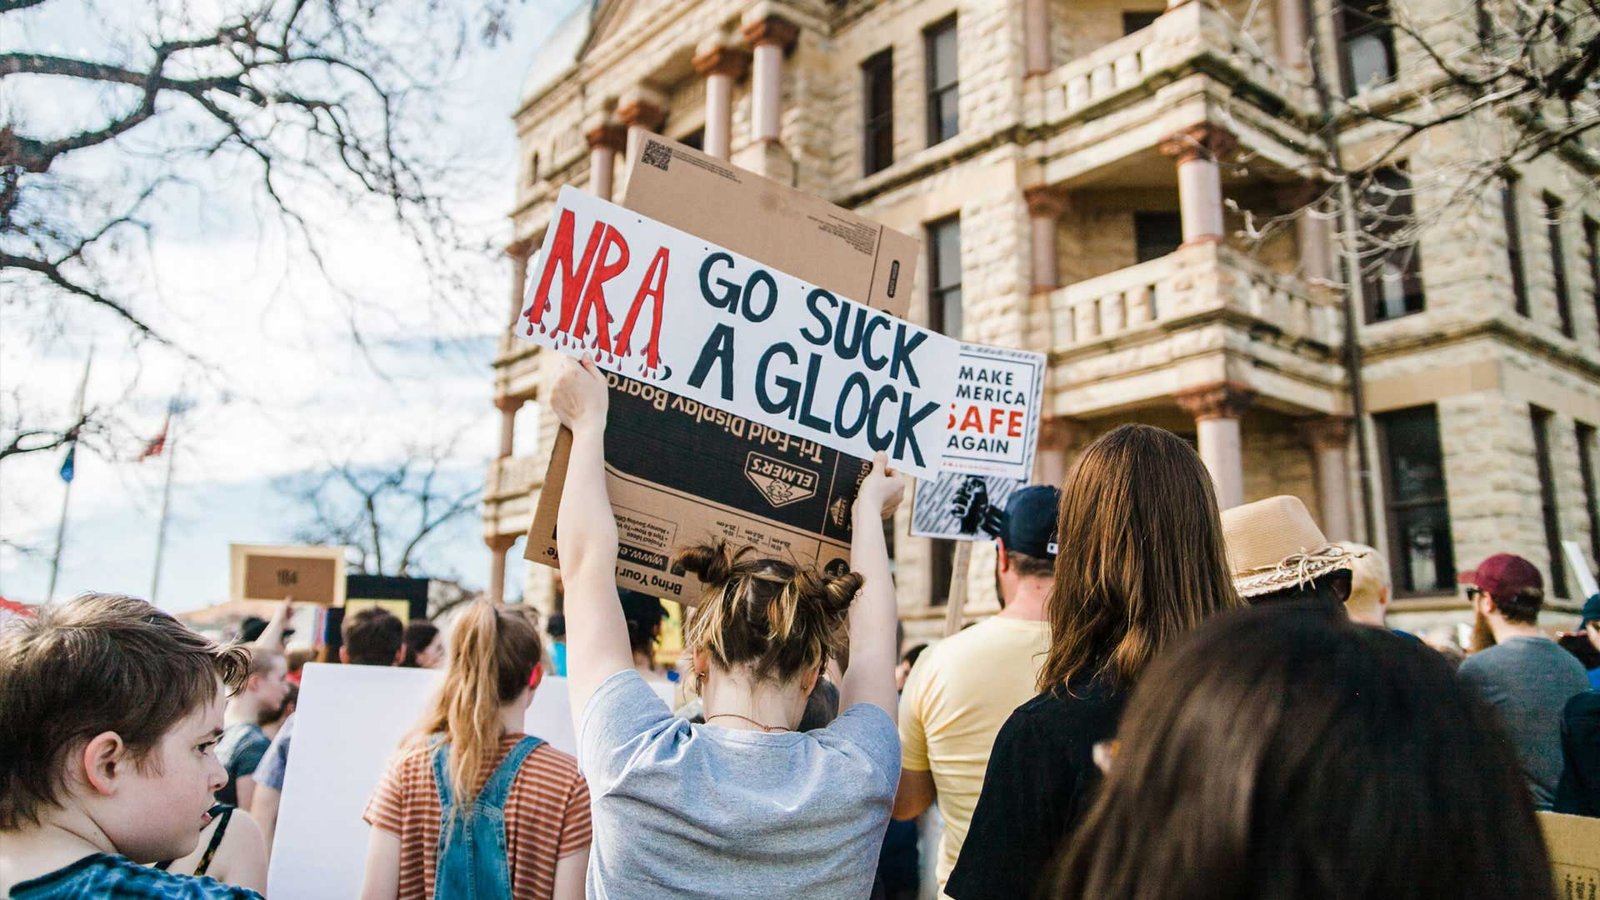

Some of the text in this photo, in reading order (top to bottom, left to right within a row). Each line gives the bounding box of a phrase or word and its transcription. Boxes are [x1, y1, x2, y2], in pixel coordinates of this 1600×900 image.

[527, 207, 671, 371] NRA
[698, 252, 928, 388] GO SUCK
[958, 365, 1014, 386] MAKE
[687, 322, 941, 468] A GLOCK
[955, 384, 1026, 406] MERICA
[747, 421, 823, 464] Tri-Fold
[947, 434, 1009, 454] AGAIN
[751, 458, 814, 488] ELMER'S
[618, 546, 663, 566] www.e
[619, 568, 648, 586] Your
[651, 575, 682, 596] Bring
